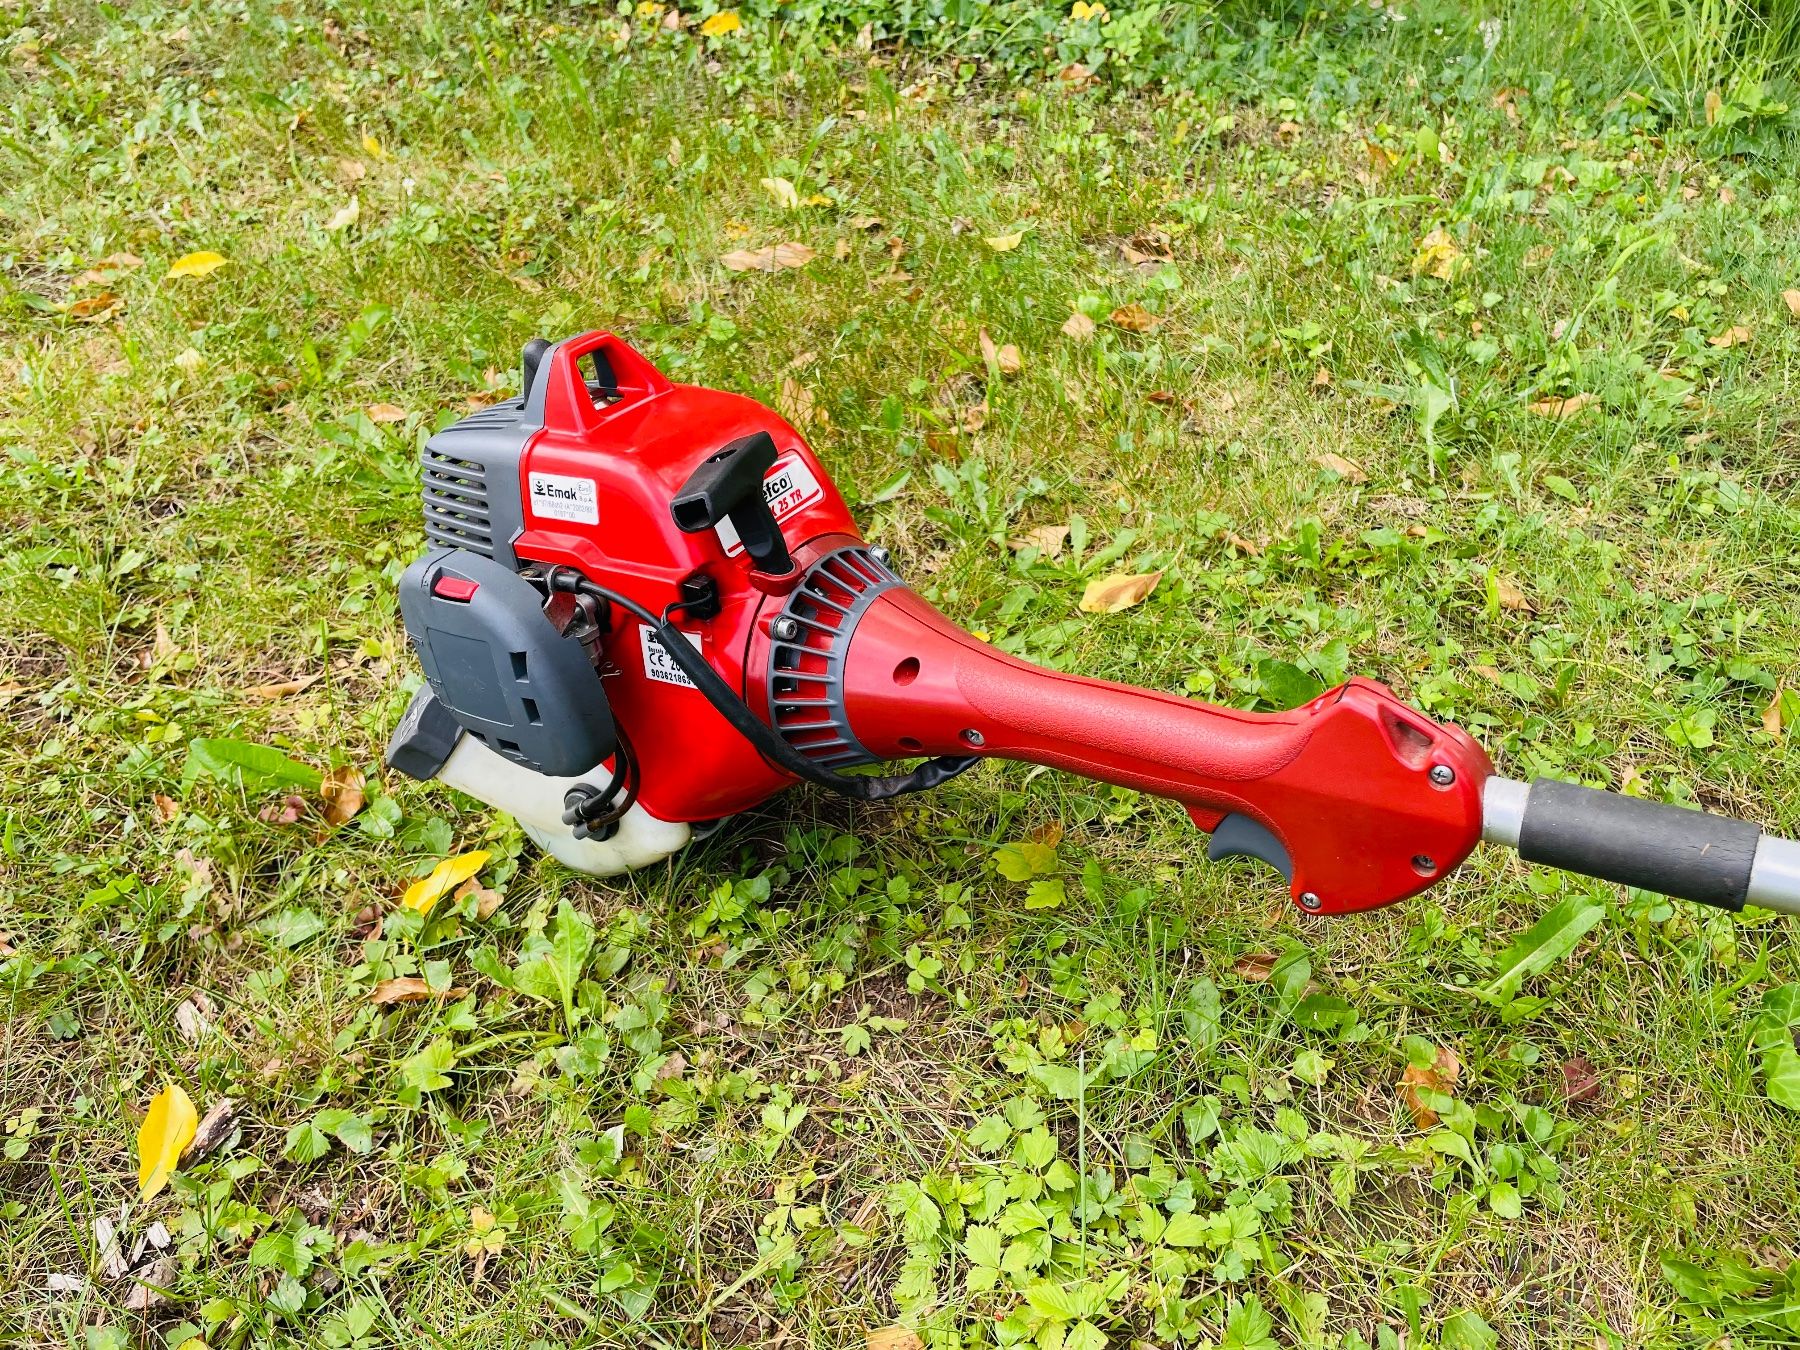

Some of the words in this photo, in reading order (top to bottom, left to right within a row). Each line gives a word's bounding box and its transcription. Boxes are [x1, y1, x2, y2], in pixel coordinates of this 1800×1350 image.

[547, 484, 577, 500] Emak
[778, 497, 789, 512] 25
[790, 489, 802, 504] TR
